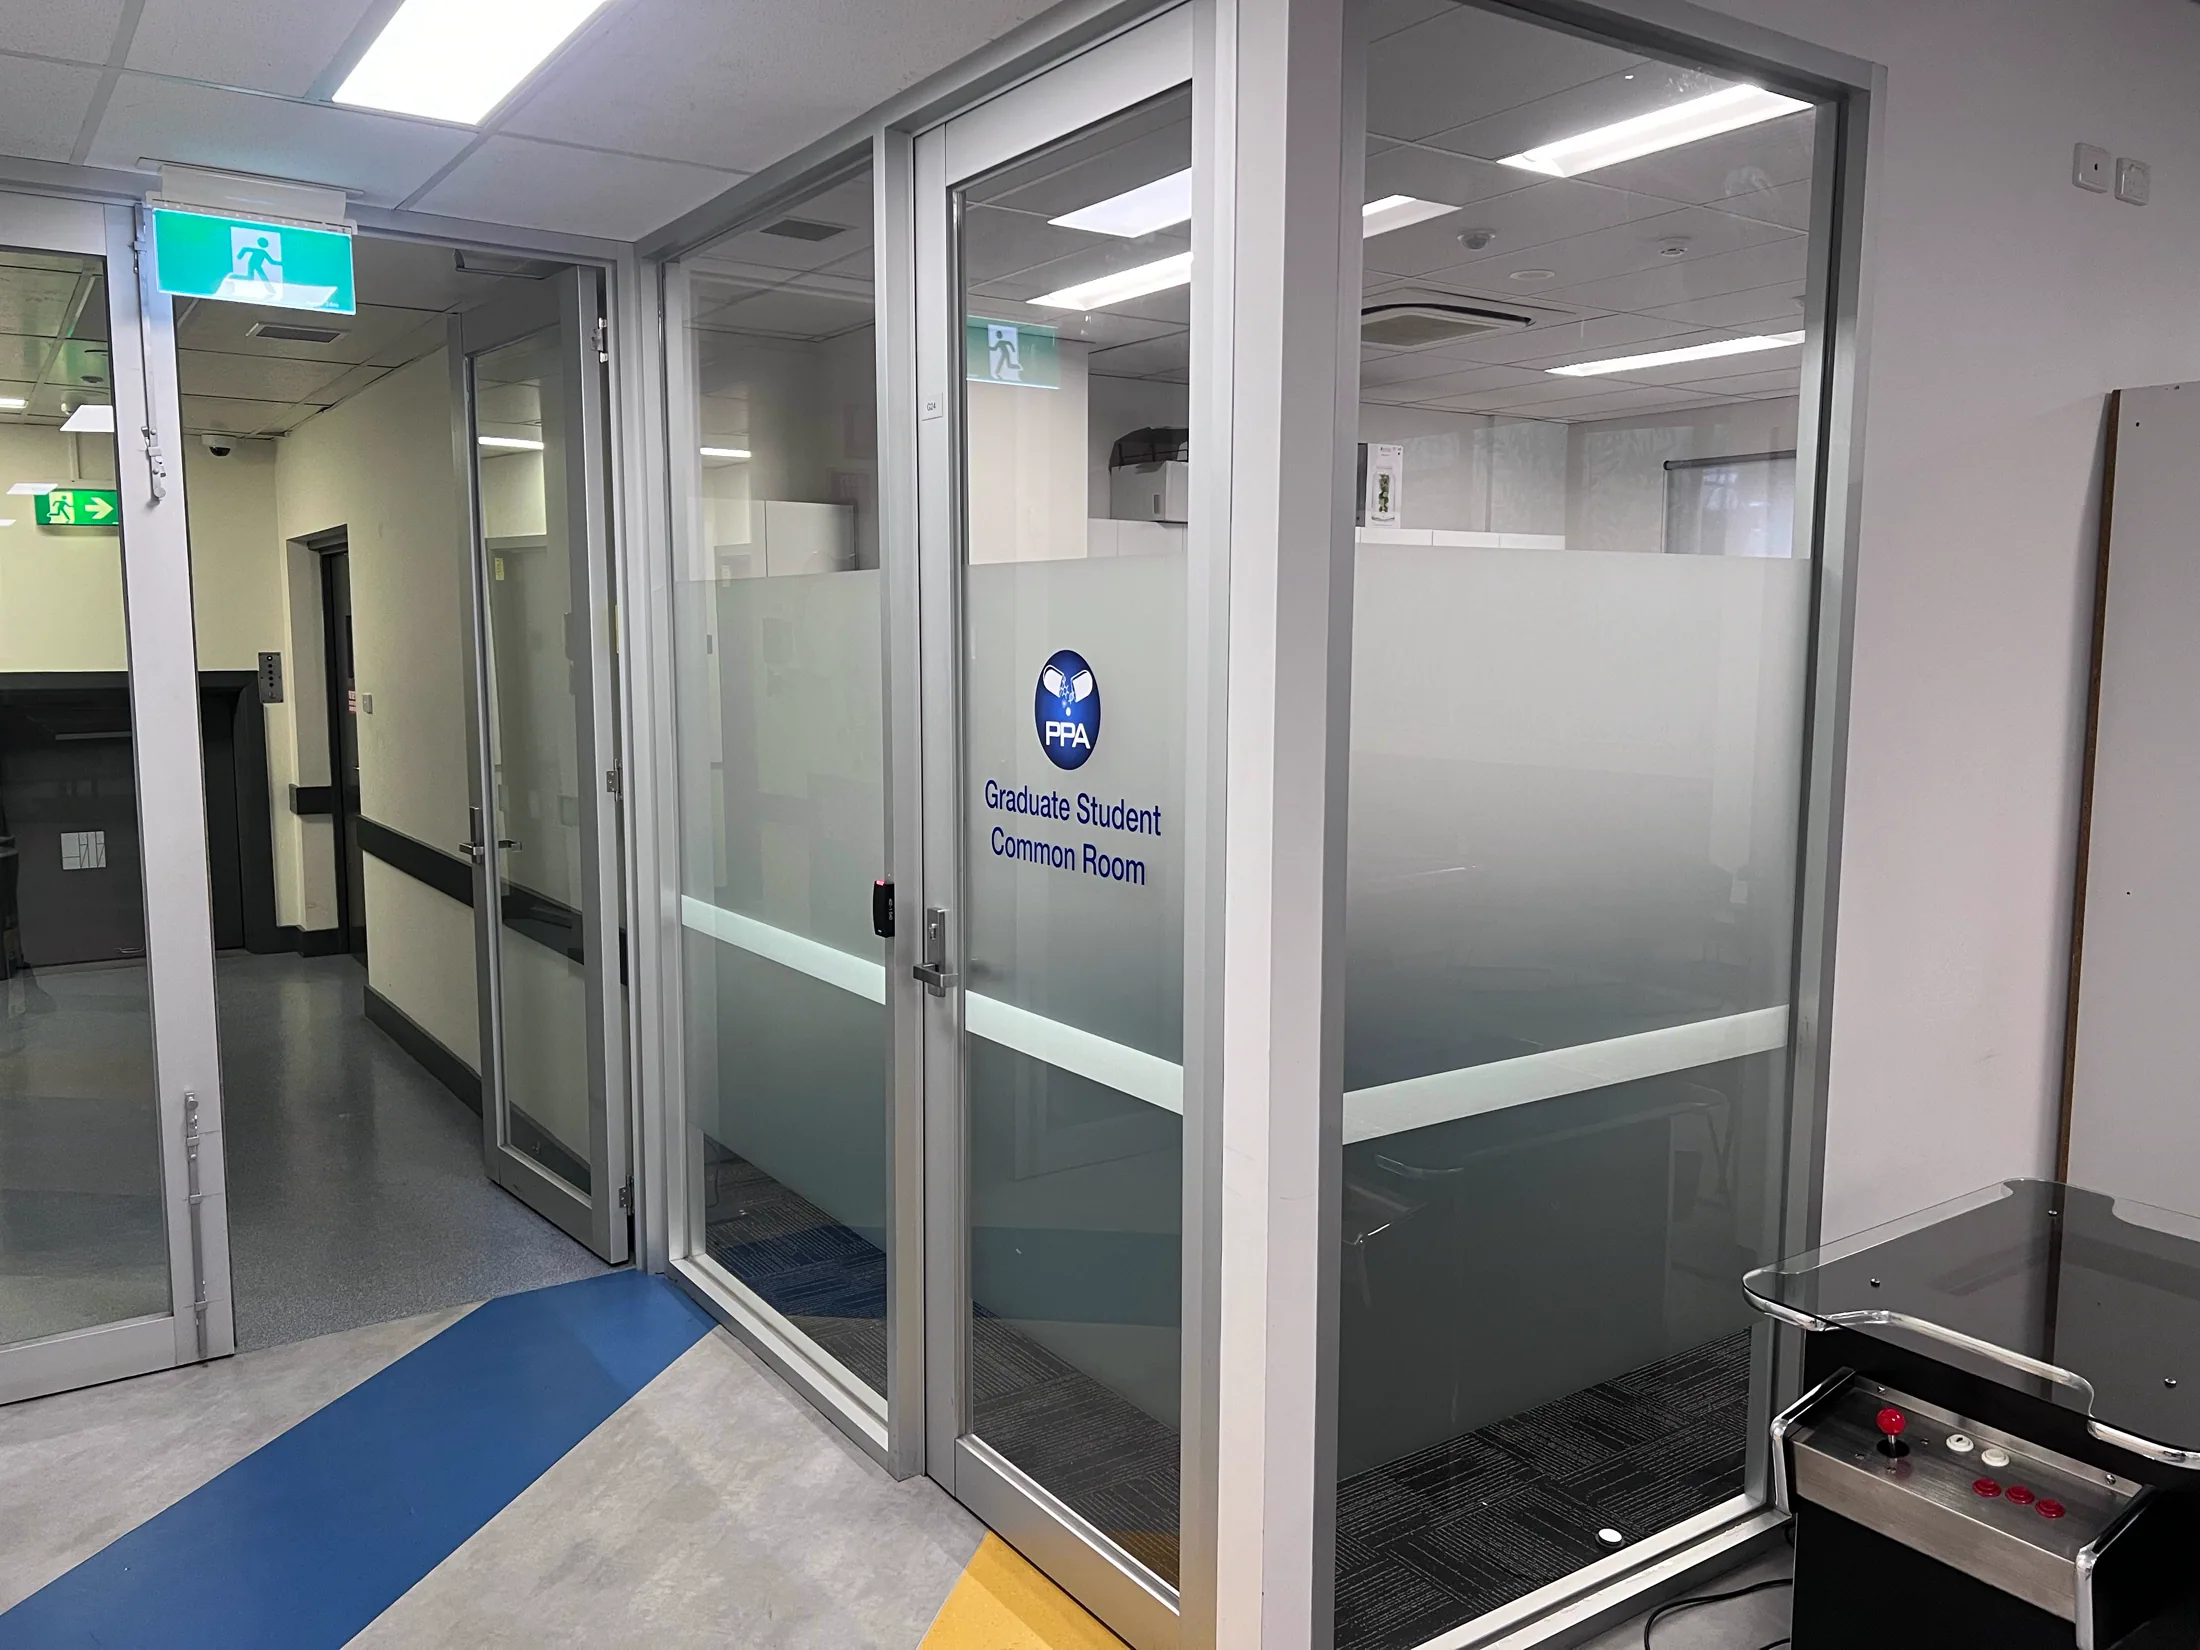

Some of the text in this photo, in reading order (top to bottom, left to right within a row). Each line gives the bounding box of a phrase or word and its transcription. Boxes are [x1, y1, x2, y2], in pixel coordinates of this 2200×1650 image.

[1045, 721, 1091, 749] PPA
[985, 780, 1161, 836] Graduate Student
[991, 826, 1146, 885] Common Room
